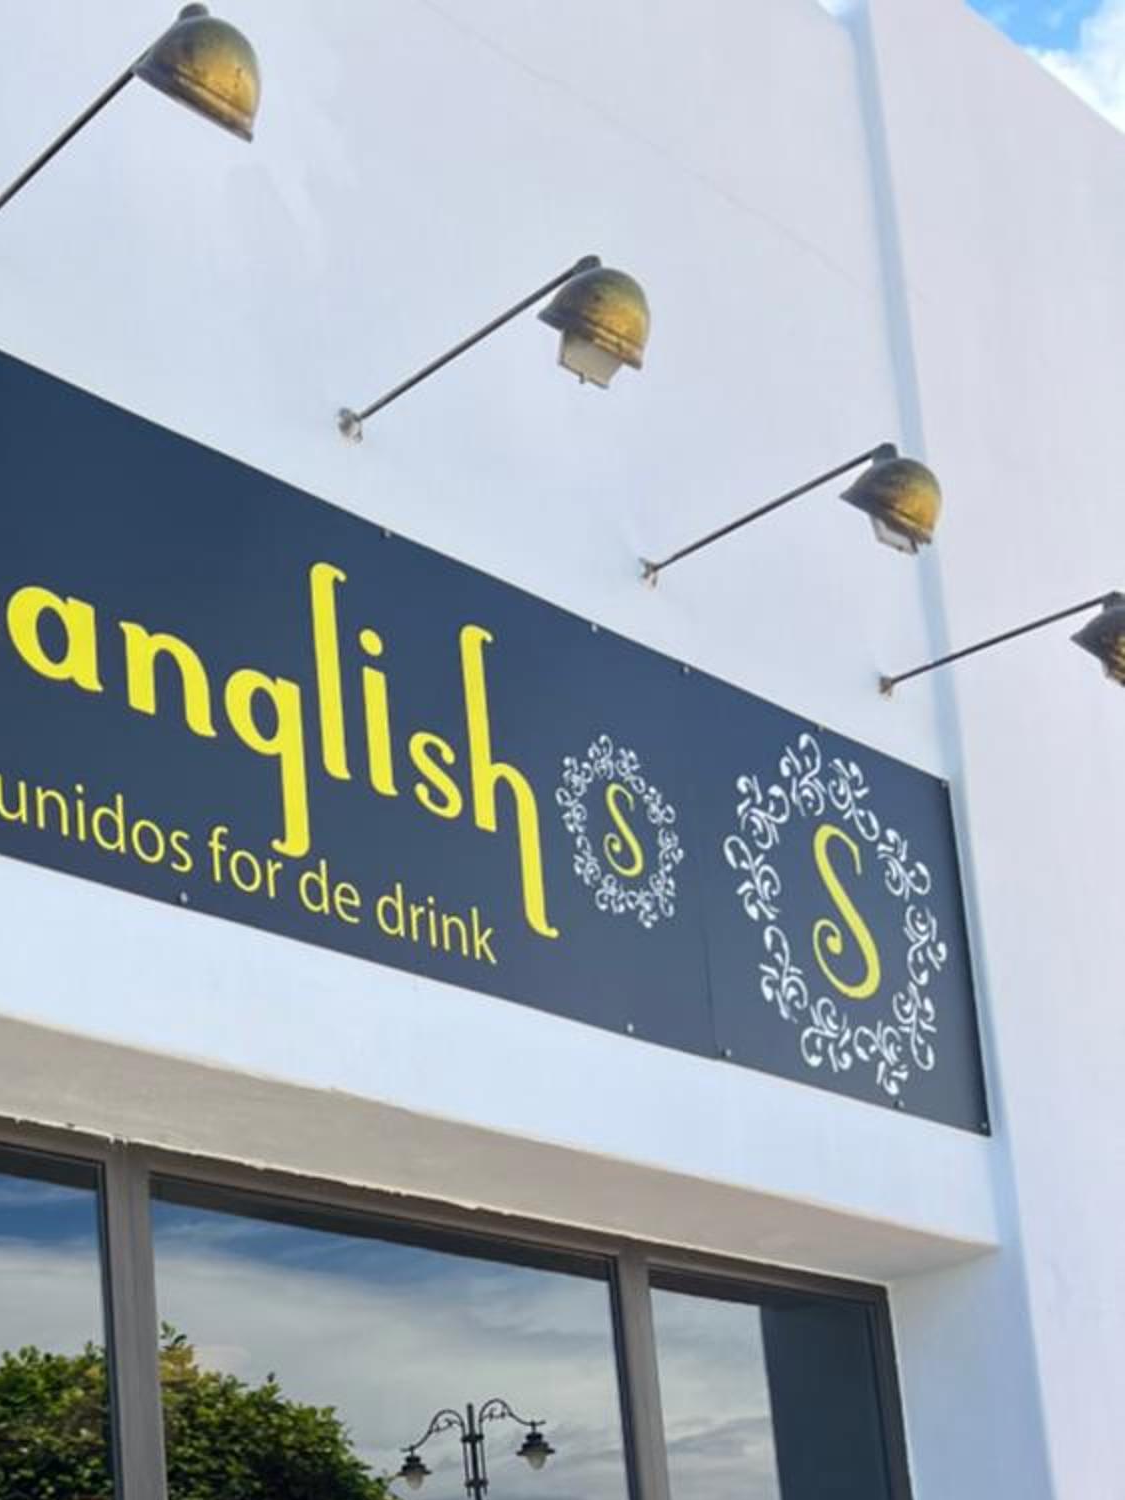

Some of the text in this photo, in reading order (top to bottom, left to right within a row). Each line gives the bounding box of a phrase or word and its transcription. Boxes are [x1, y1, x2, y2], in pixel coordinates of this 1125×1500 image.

[208, 825, 283, 899] for
[299, 859, 362, 924] de
[376, 882, 498, 965] drink
[603, 782, 644, 878] S
[812, 823, 881, 999] S
